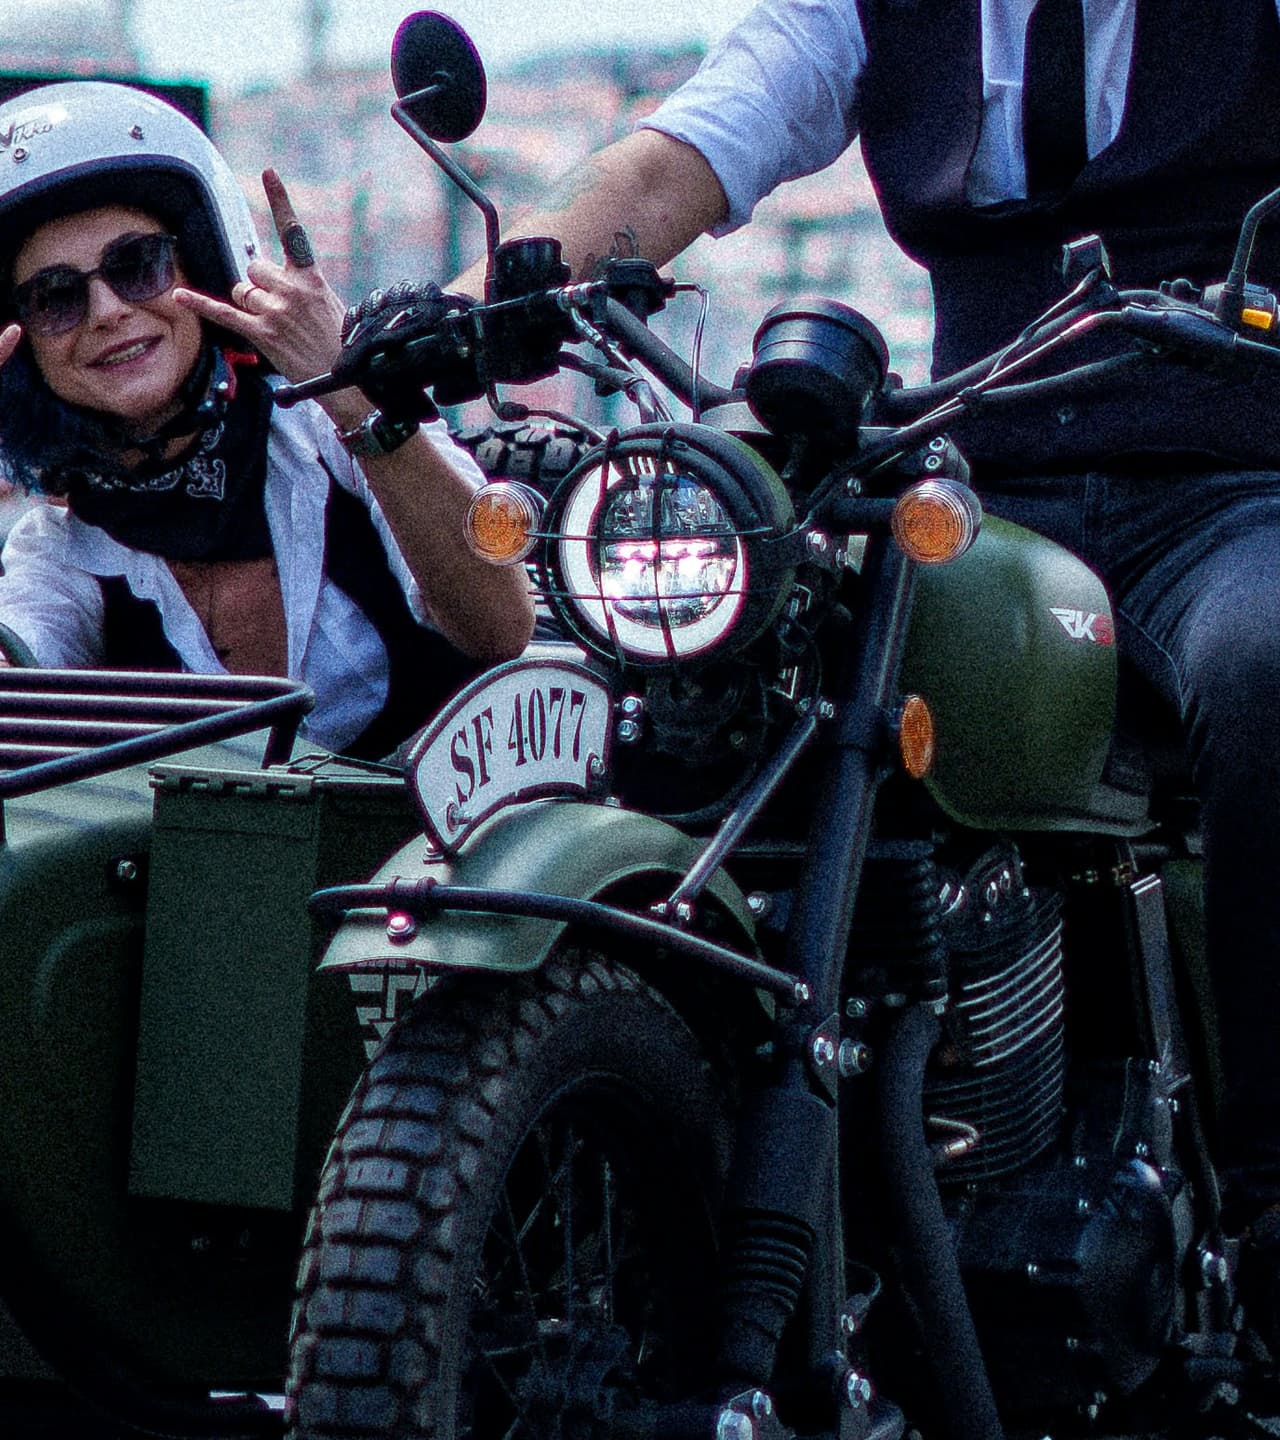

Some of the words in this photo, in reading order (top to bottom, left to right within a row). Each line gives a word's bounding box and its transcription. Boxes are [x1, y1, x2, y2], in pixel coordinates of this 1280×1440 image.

[1048, 606, 1115, 646] RKS
[449, 705, 497, 804] SF
[507, 686, 588, 768] 4077
